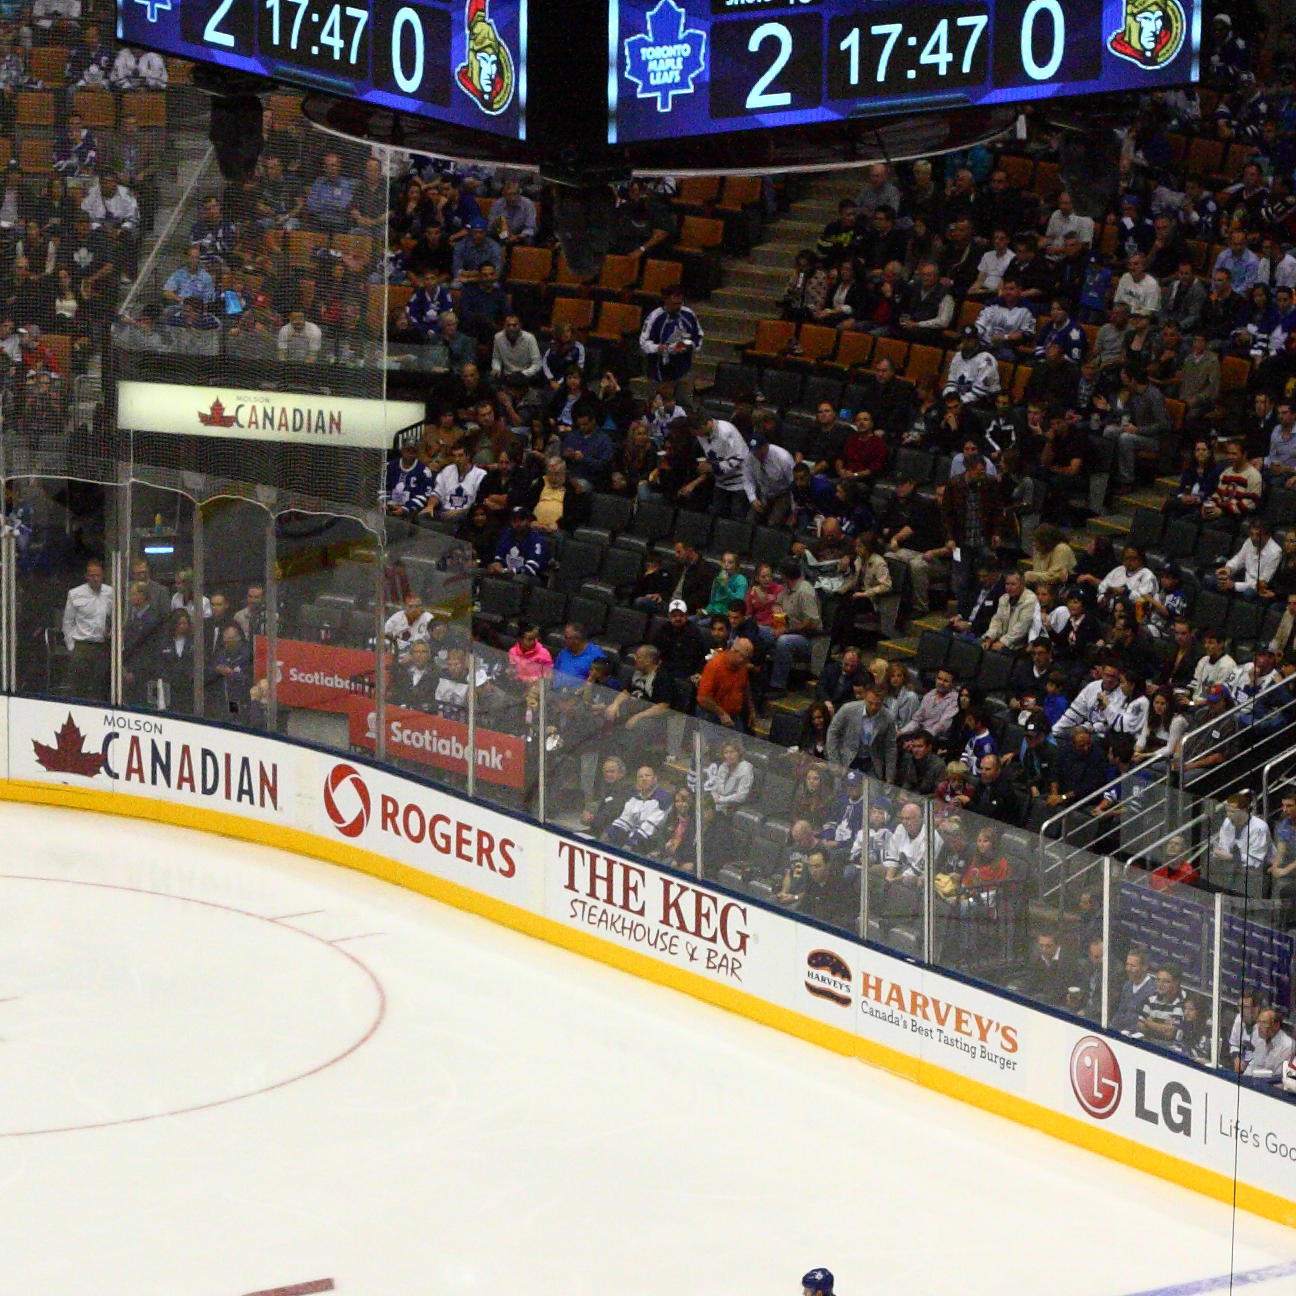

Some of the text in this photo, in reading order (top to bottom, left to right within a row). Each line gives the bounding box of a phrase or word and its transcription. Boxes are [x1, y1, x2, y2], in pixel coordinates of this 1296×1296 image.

[267, 0, 369, 65] 17:47
[392, 7, 424, 93] 0
[640, 43, 691, 60] TORONTO
[647, 57, 683, 72] MAPLE
[745, 22, 793, 109] 2
[839, 14, 988, 85] 17:47
[1020, 0, 1065, 80] 0
[649, 70, 681, 85] LEAFS
[234, 403, 342, 435] CANADIAN
[103, 714, 163, 736] MOLSON
[101, 729, 279, 813] CANADIAN
[381, 793, 517, 879] ROGERS
[558, 840, 751, 957] THE KEG
[570, 897, 680, 957] STEAKHOUSE
[705, 949, 744, 984] BAR
[807, 969, 852, 994] HARVEY'S
[861, 971, 1020, 1055] HARVEY'S
[861, 1000, 1018, 1073] Canada's Best Tasting Burger
[1134, 1068, 1193, 1138] LG
[1218, 1112, 1261, 1148] Life's
